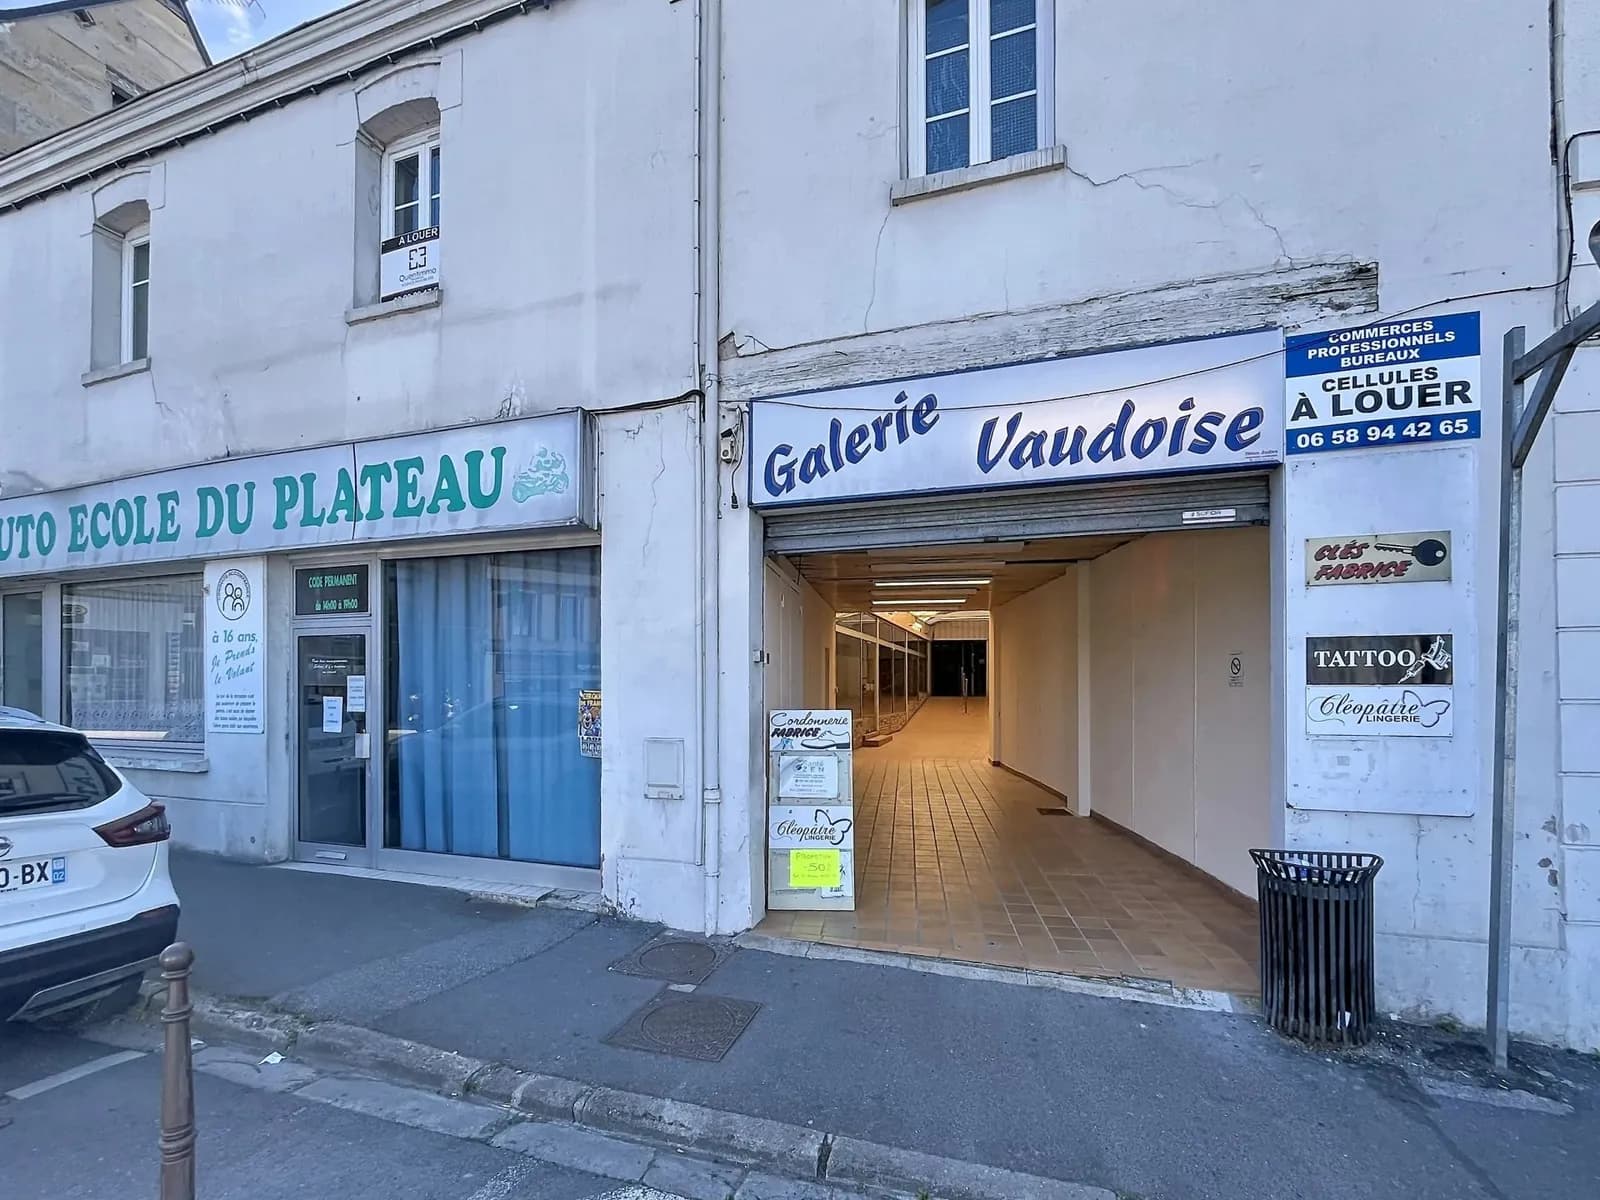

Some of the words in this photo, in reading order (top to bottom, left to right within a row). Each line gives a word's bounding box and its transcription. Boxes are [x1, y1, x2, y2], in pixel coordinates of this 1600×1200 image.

[399, 236, 405, 245] A
[407, 227, 438, 243] LOUER
[1328, 320, 1433, 343] COMMERCES
[1308, 331, 1456, 359] PROFESSIONNELS
[1340, 348, 1420, 368] BUREAUX
[1321, 366, 1438, 392] CELLULES
[1290, 392, 1317, 421] À
[1331, 380, 1472, 417] LOUER
[763, 390, 939, 497] Galerie
[976, 397, 1264, 474] Vaudoise
[1296, 433, 1325, 448] 06
[1331, 428, 1359, 445] 58
[1367, 425, 1395, 441] 94
[1402, 421, 1431, 438] 42
[1439, 418, 1469, 435] 65
[68, 490, 181, 553] ECOLE
[195, 481, 256, 539] DU
[273, 446, 507, 530] PLATEAU
[308, 575, 323, 588] CODE
[324, 573, 358, 587] PERMANENT
[1314, 560, 1413, 581] FABRICE
[212, 630, 219, 643] à
[223, 629, 234, 643] 16
[210, 655, 220, 673] Je
[224, 643, 255, 664] Prends
[1314, 649, 1416, 668] TATTOO
[225, 661, 255, 680] Volant
[1319, 693, 1419, 724] Cléopâtre
[1366, 714, 1420, 723] LINGERIE
[771, 712, 848, 727] Cordonnerie
[771, 728, 821, 738] FABRICE
[776, 819, 836, 842] Cléopâtre
[53, 872, 65, 881] 02
